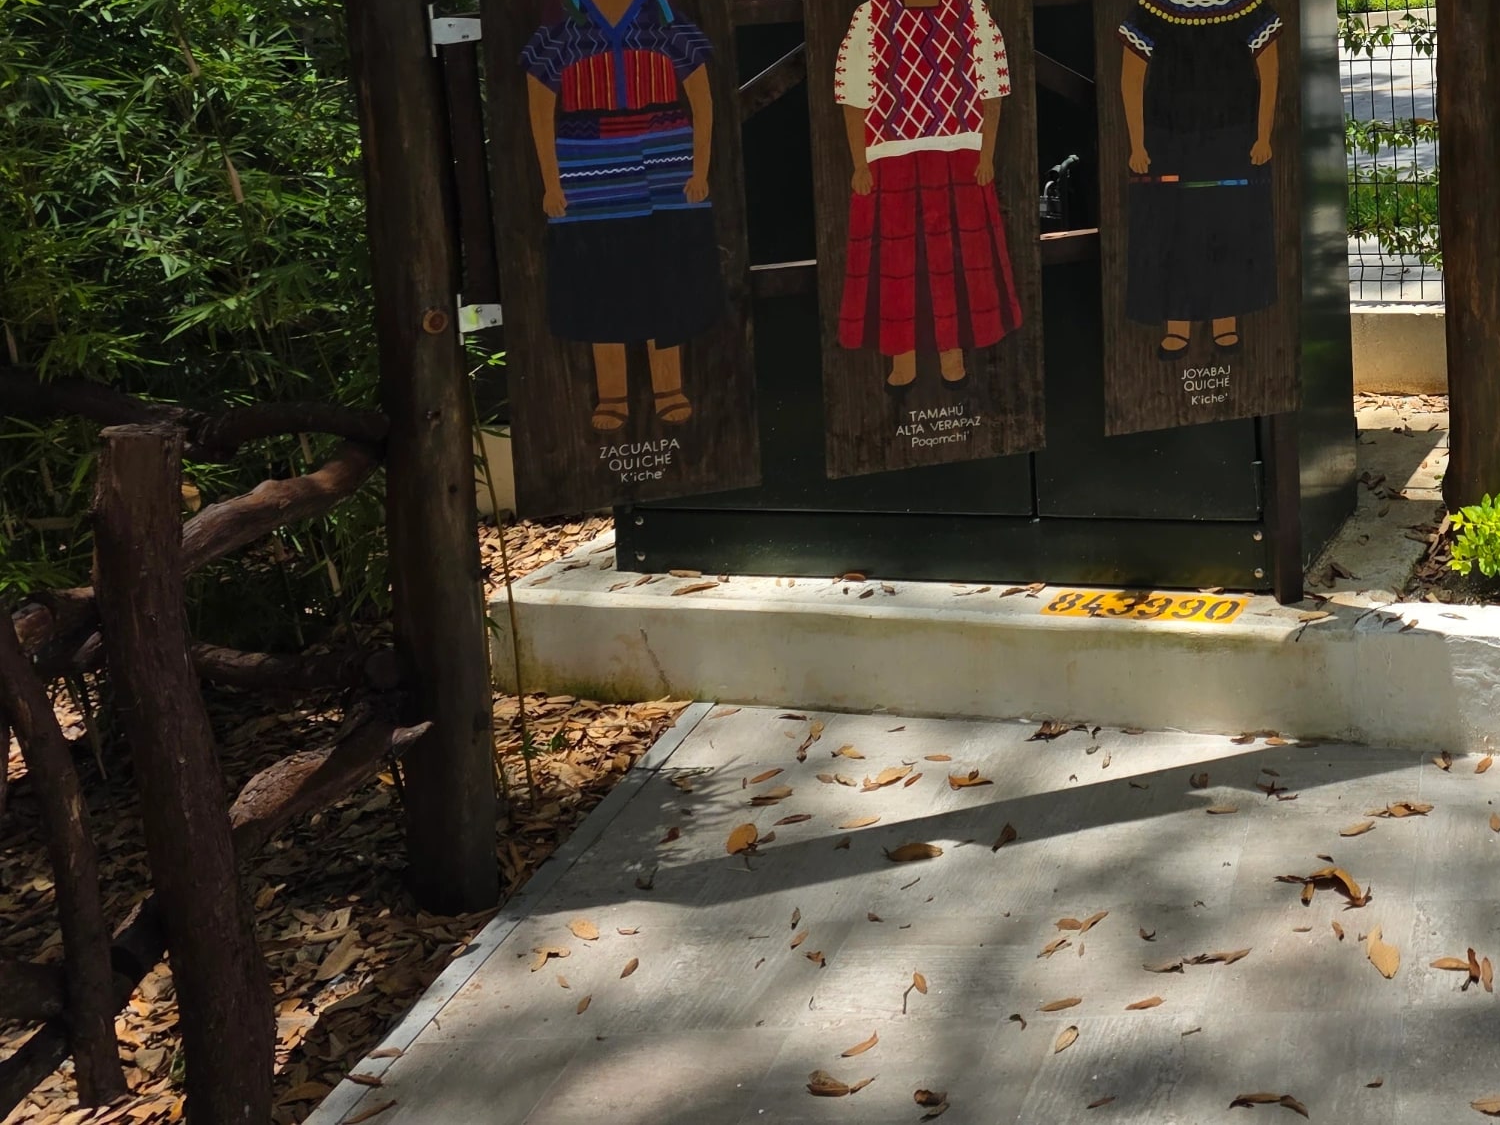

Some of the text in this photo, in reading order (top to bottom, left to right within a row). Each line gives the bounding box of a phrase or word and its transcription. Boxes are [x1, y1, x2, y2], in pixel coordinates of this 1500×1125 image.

[1181, 364, 1231, 380] JOYABAJ
[909, 402, 964, 422] TAMAHÚ
[895, 416, 981, 437] ALTA VERAPAZ
[599, 438, 680, 459] ZACUALPA
